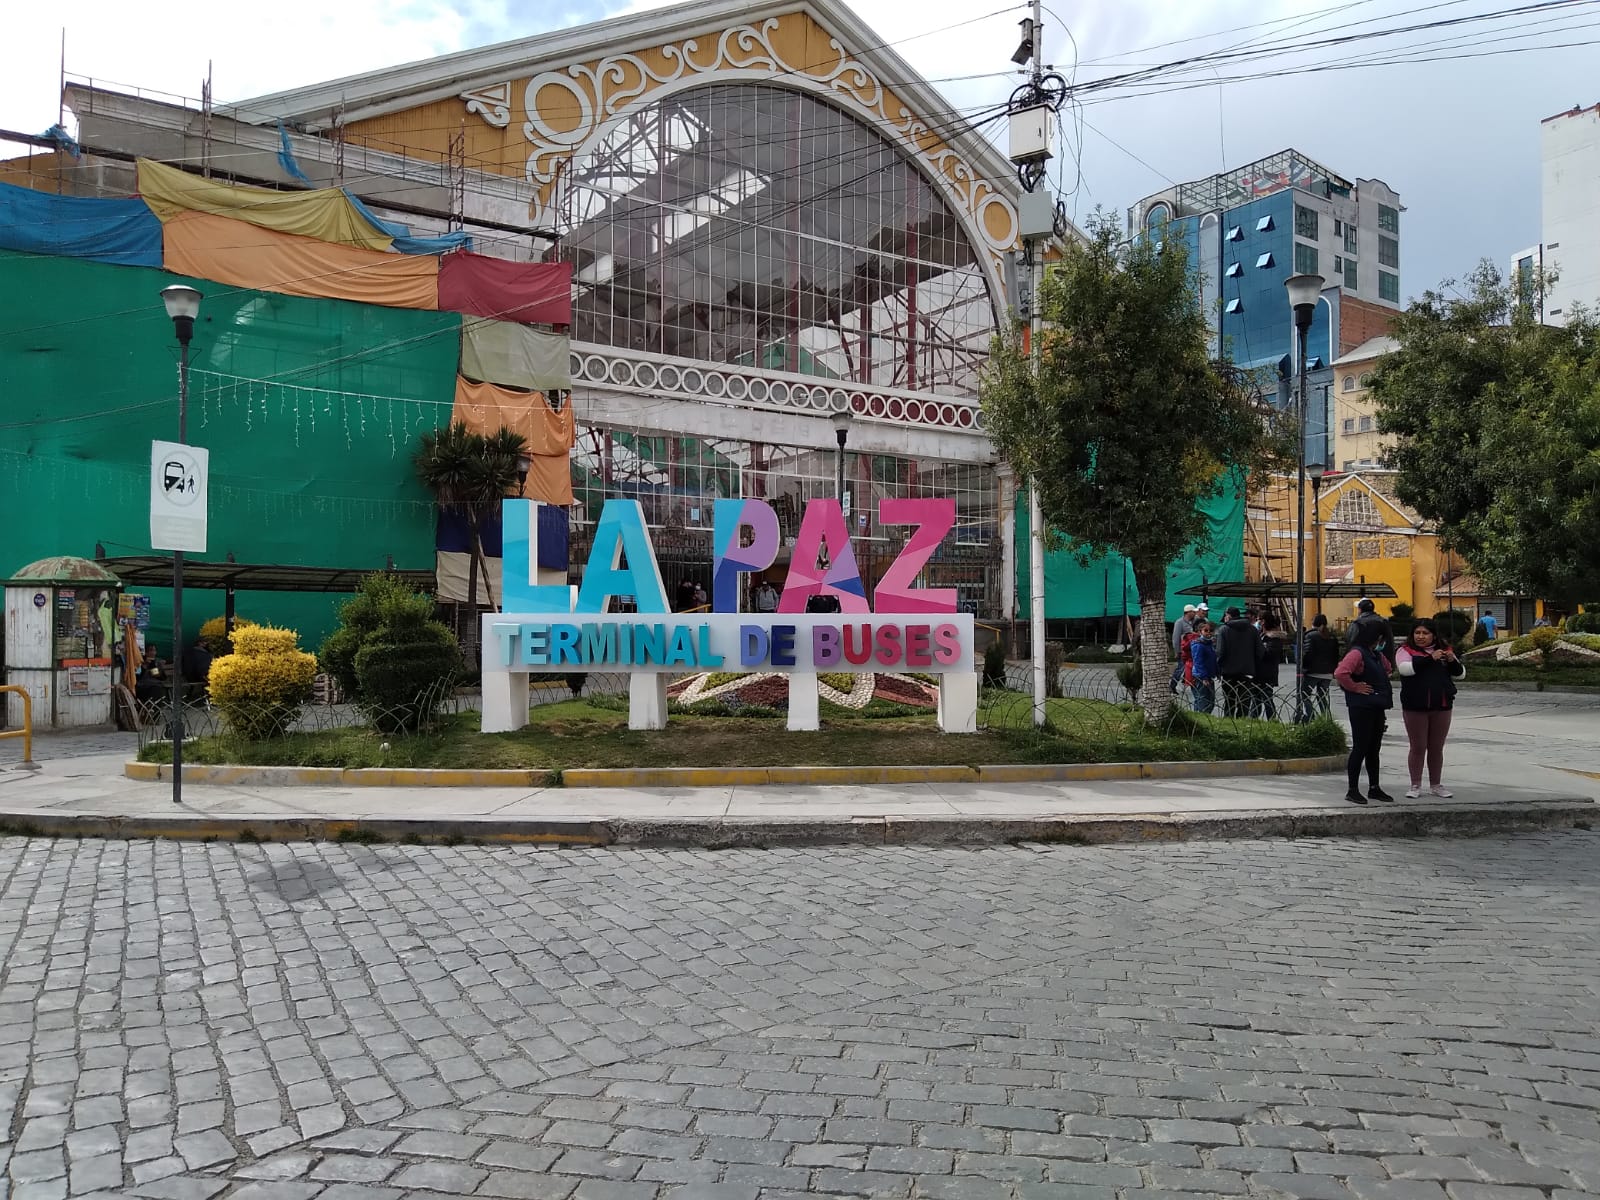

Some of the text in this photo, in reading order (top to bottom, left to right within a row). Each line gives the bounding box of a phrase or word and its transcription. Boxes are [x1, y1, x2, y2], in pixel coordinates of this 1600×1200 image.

[502, 499, 957, 613] LA PAZ
[491, 623, 961, 667] TERMINAL DE BUSES
